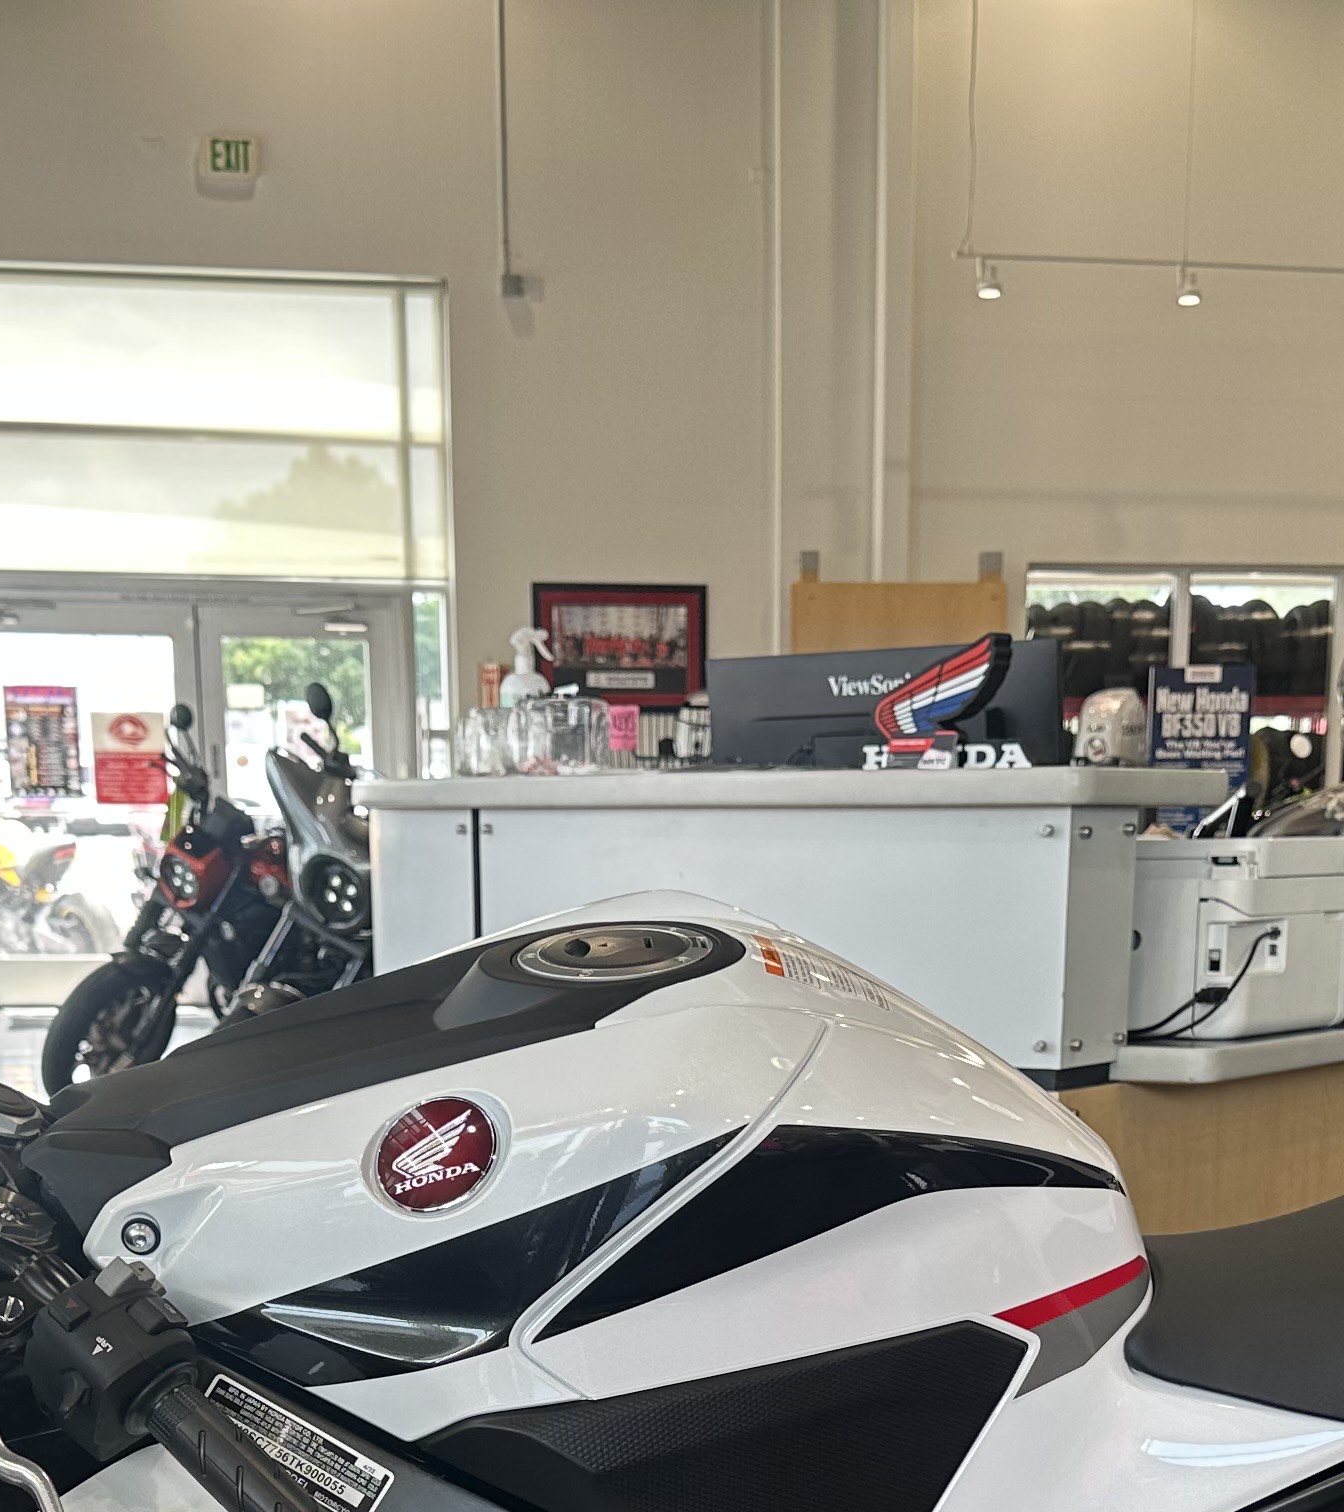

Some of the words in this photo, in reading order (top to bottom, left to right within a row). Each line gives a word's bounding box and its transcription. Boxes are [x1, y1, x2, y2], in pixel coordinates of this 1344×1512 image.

[210, 138, 249, 173] EXIT
[1156, 686, 1195, 713] New
[1195, 685, 1250, 713] Honda
[394, 1162, 481, 1195] HONDA
[95, 1336, 113, 1353] LAP
